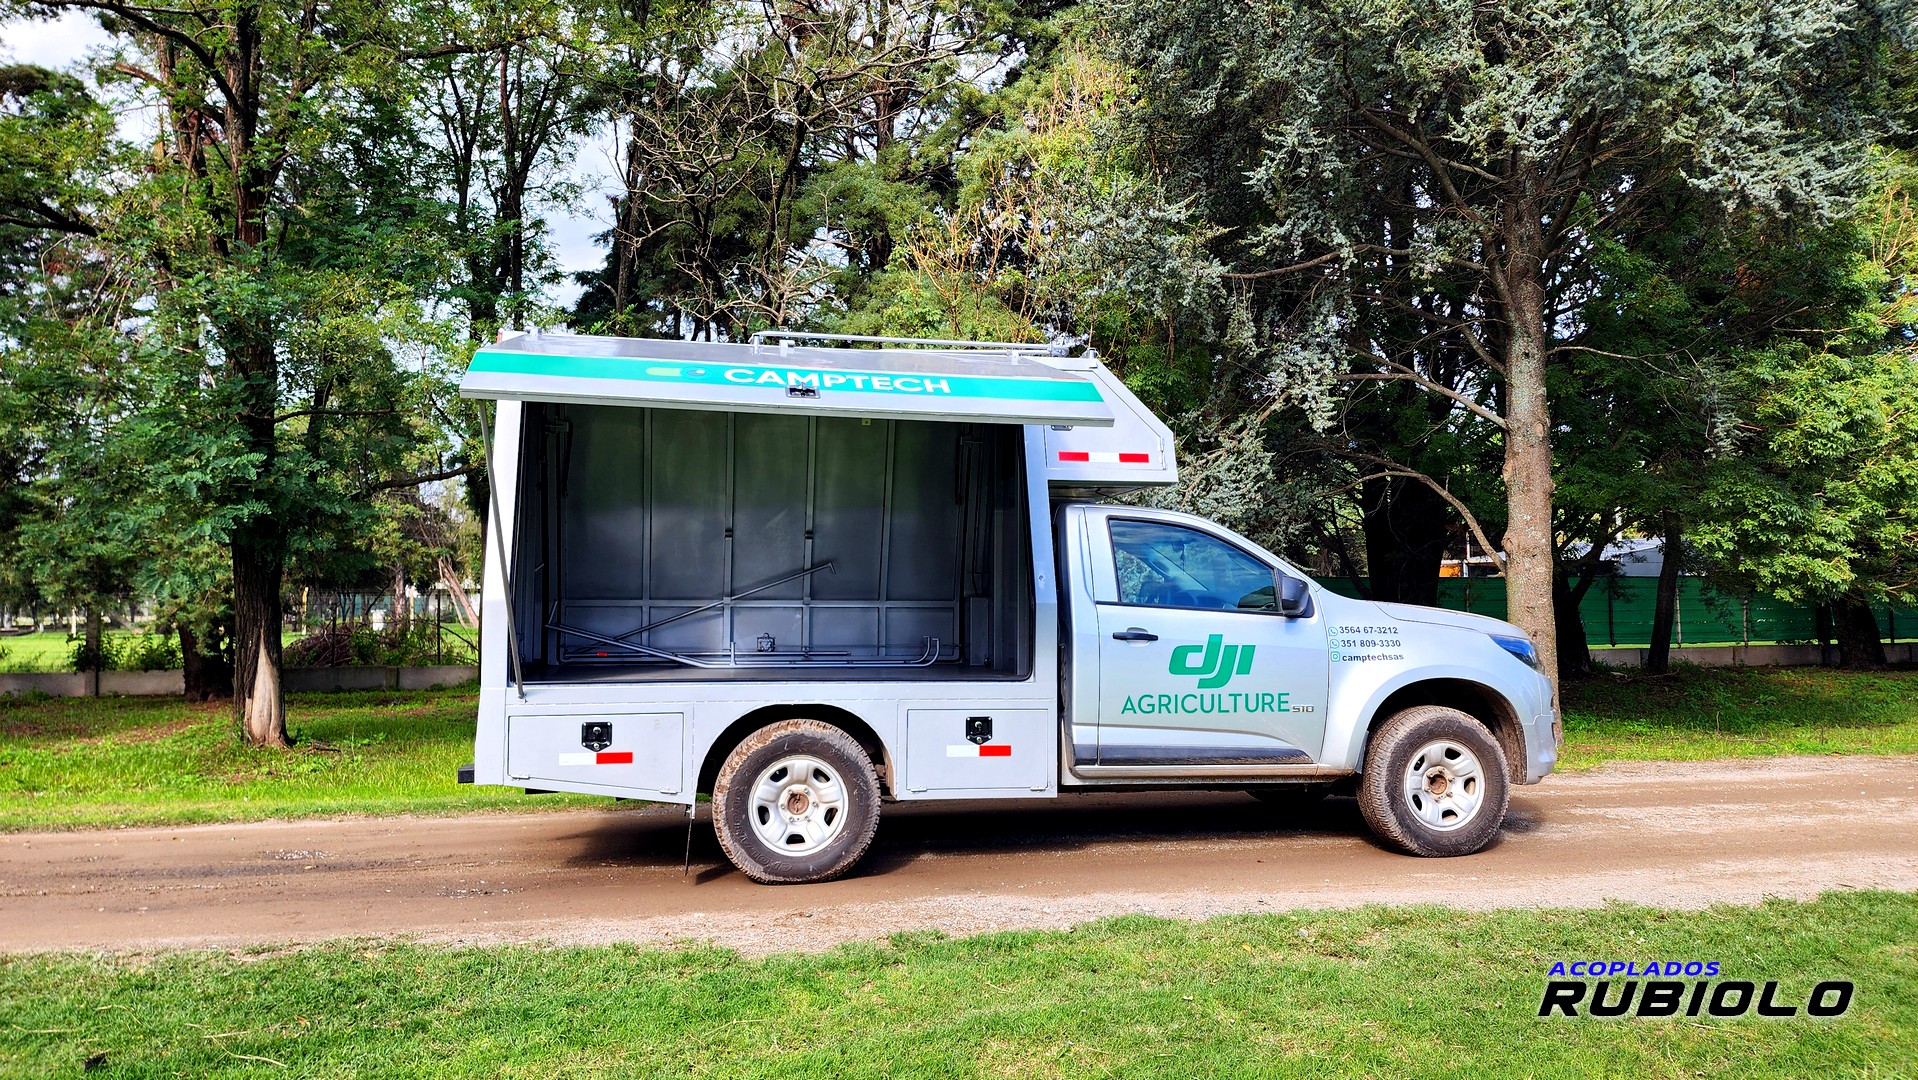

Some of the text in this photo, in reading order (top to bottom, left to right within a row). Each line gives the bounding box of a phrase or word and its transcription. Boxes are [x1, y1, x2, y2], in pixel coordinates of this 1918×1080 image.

[723, 367, 952, 394] CAMPTECH
[1339, 625, 1399, 635] 3564 67-3212
[1341, 639, 1402, 648] 351 809-3330
[1341, 653, 1405, 664] camptechsas
[1121, 692, 1290, 715] AGRICULTURE
[1292, 705, 1315, 713] S10
